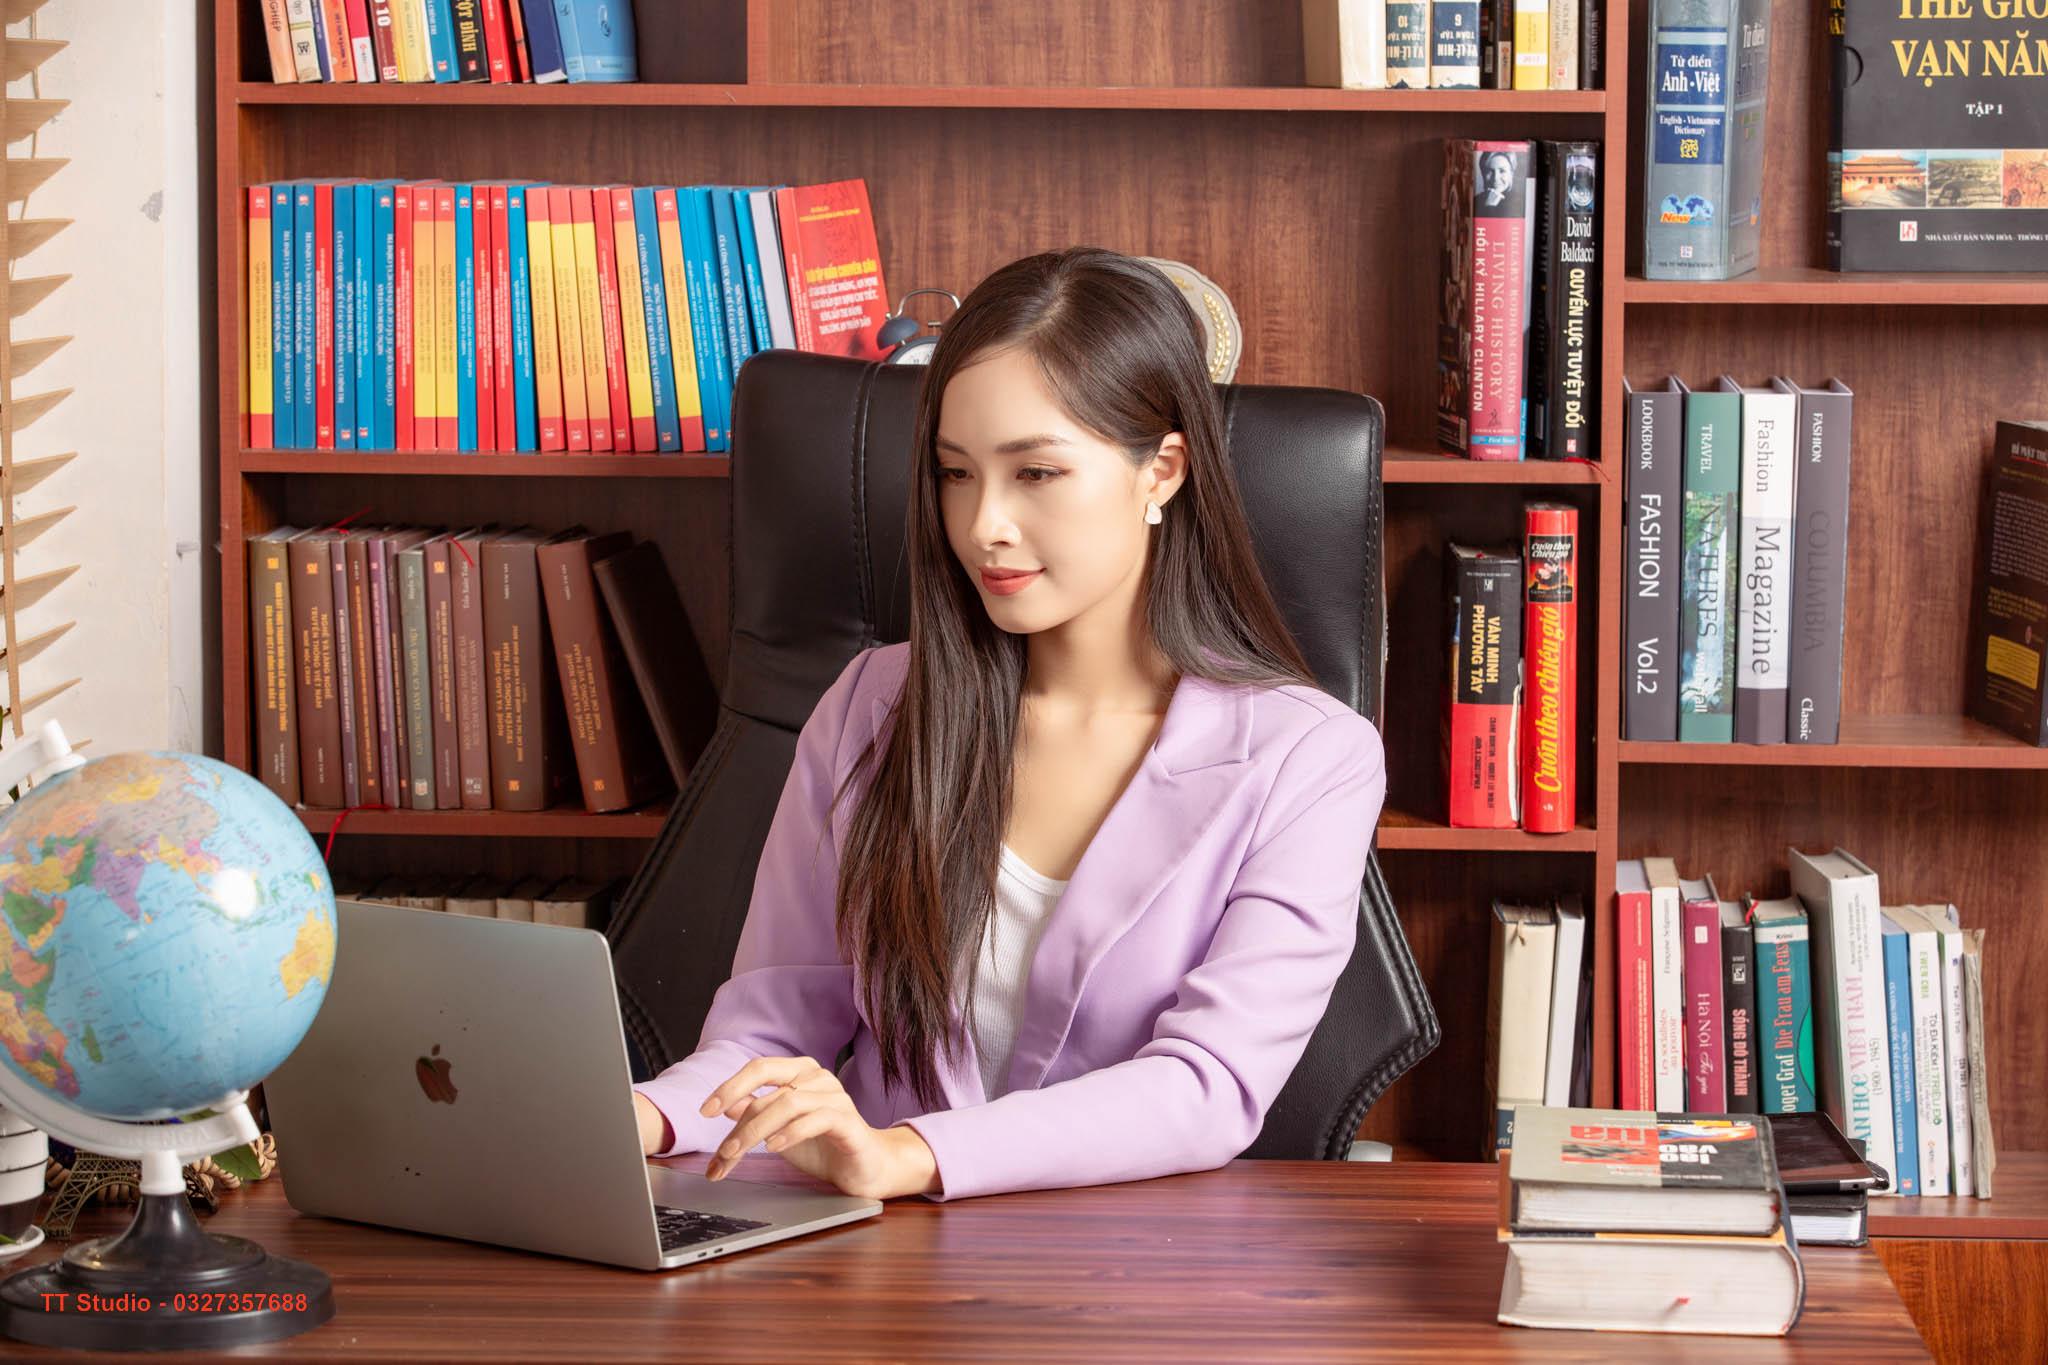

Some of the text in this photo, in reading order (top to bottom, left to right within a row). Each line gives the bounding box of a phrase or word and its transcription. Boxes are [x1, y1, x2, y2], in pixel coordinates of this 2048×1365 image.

[1397, 15, 1407, 28] 10
[1670, 54, 1712, 68] Từ điển
[1891, 40, 1973, 88] VẠN
[1661, 72, 1689, 93] Anh
[1695, 70, 1721, 97] Việt
[1965, 101, 2003, 117] TẬP 1
[1674, 125, 1706, 136] Dictionary
[1567, 216, 1592, 238] David
[1659, 213, 1691, 224] New
[1560, 241, 1595, 263] Baldacci
[1474, 283, 1484, 342] HILLARY
[1488, 241, 1506, 400] LIVING HISTORY
[1562, 318, 1584, 347] LỰC
[1473, 349, 1483, 411] CLINTON
[1561, 349, 1585, 397] TUYỆT
[1699, 424, 1713, 473] TRAVEL
[1636, 399, 1661, 693] LOOKBOOK FASHION Vol.2
[1744, 419, 1781, 674] Fashion Magazine
[1694, 505, 1722, 637] NATURES
[1799, 412, 1829, 740] FASHION COLUMBIA Classic
[1537, 605, 1565, 640] gió
[1470, 604, 1486, 694] PHƯƠNG TÂY
[1485, 616, 1501, 682] VĂN MINH
[1534, 694, 1559, 737] theo
[1777, 974, 1791, 993] am
[1844, 975, 1864, 1019] NAM
[1773, 996, 1792, 1025] Frau
[1775, 1028, 1793, 1048] Die
[1775, 1053, 1794, 1080] Graf
[1780, 1083, 1799, 1112] oger
